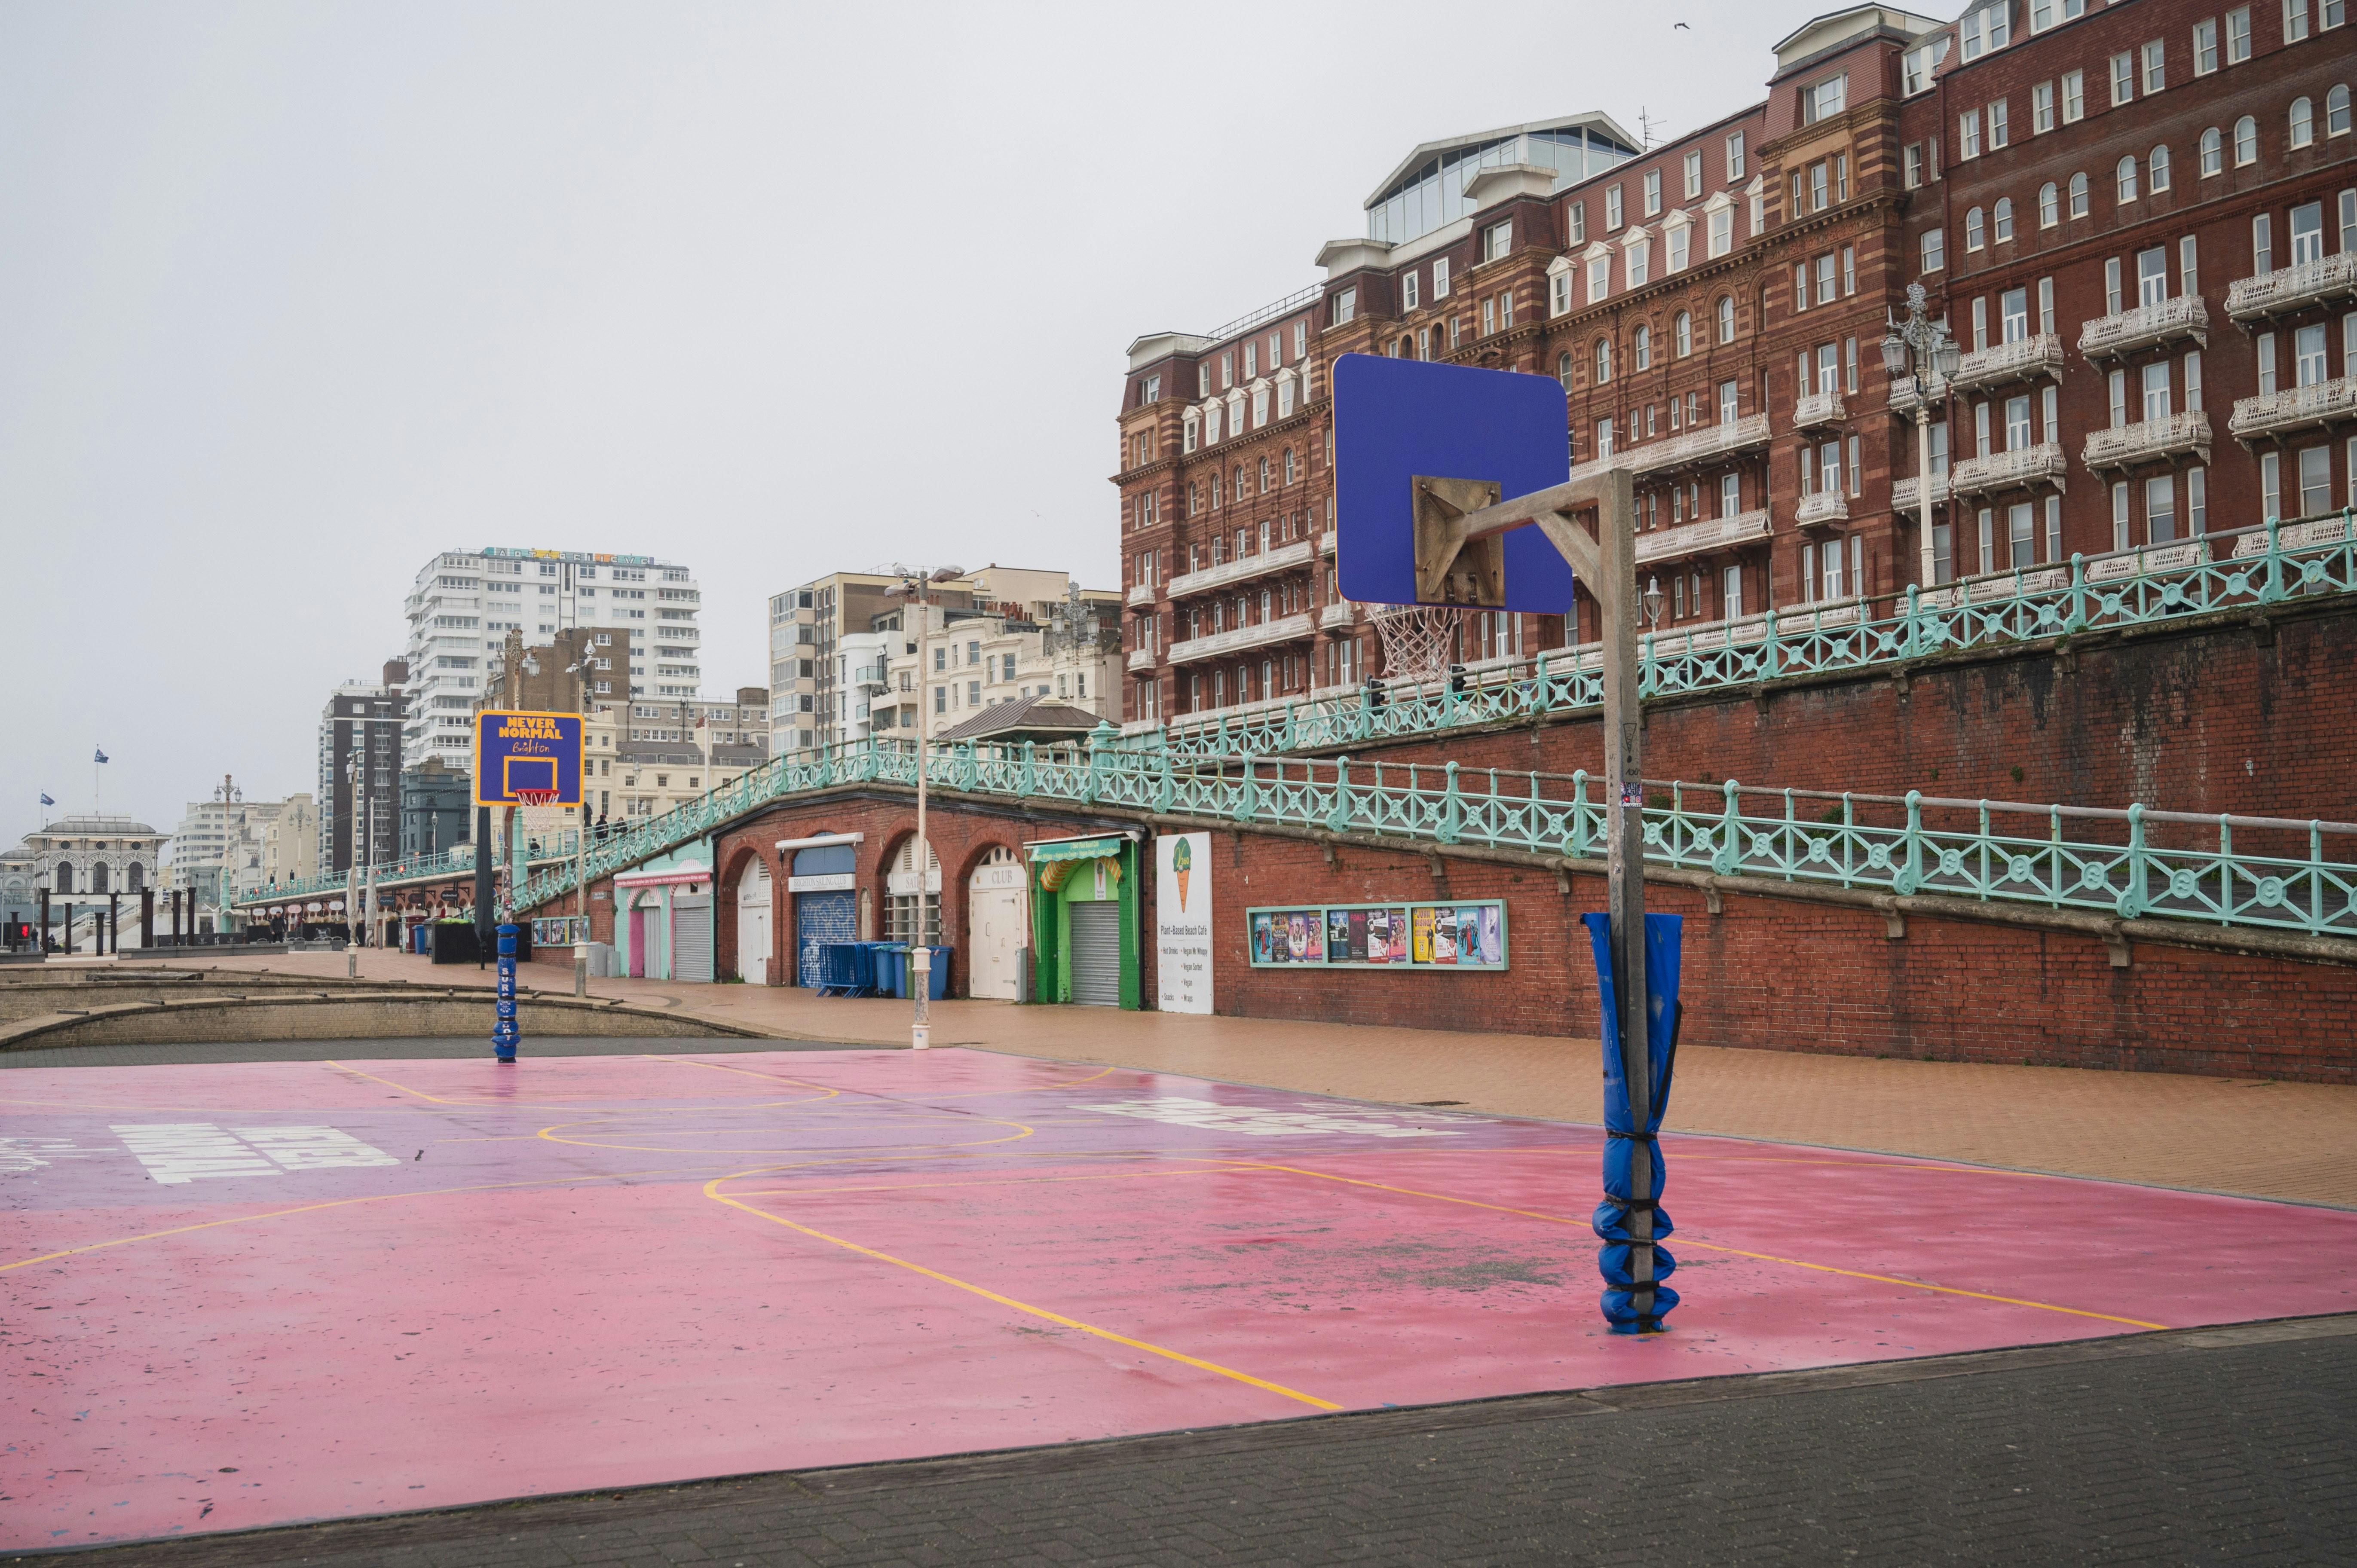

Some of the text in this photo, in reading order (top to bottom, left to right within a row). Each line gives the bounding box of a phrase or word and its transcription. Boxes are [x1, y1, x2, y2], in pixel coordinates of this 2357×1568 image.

[507, 717, 555, 728] NEVER
[499, 727, 563, 739] NORMAL
[512, 739, 550, 755] Brighton
[52, 855, 78, 866] WEST BEACH
[104, 856, 113, 865] BAR
[123, 855, 149, 866] WEST BEACH
[794, 875, 846, 887] BRIGHTON SAILING CLUB
[906, 870, 1013, 889] SAILNG CLUB
[1417, 910, 1430, 918] JOHN
[1161, 925, 1207, 935] Plant-Based Beach Café
[1183, 947, 1192, 957] Vegan
[1197, 947, 1208, 957] Whippy
[1183, 963, 1203, 972] Vegan Sorbet
[1183, 978, 1193, 988] Vegan
[1164, 993, 1174, 1001] Snacks
[1184, 994, 1193, 1004] Wraps
